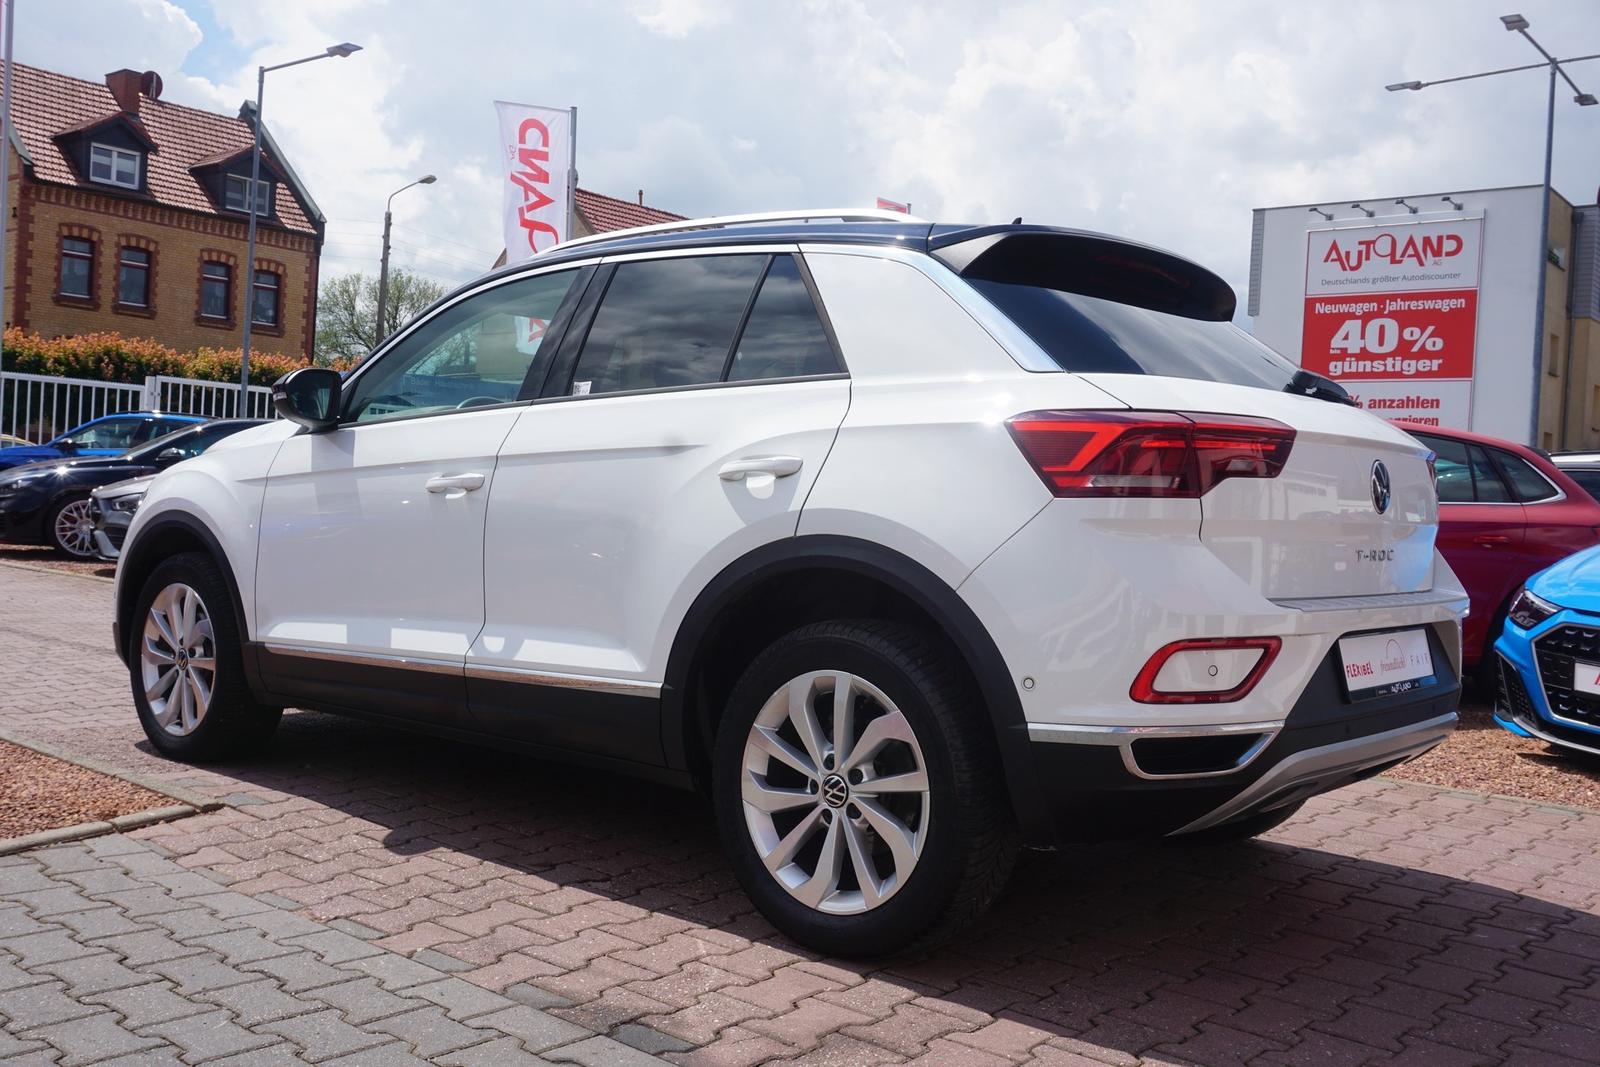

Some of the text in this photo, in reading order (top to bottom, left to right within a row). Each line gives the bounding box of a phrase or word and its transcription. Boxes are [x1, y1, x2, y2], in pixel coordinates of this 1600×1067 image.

[1323, 233, 1464, 272] AUTOLAND
[1432, 259, 1443, 267] AG
[1321, 272, 1462, 286] Deutschlands größter Autodiscounter
[1315, 298, 1466, 316] Neuwagen Jahreswagen
[1328, 357, 1443, 376] günstiger
[1367, 395, 1441, 409] anzahlen
[1355, 549, 1395, 562] T-ROC
